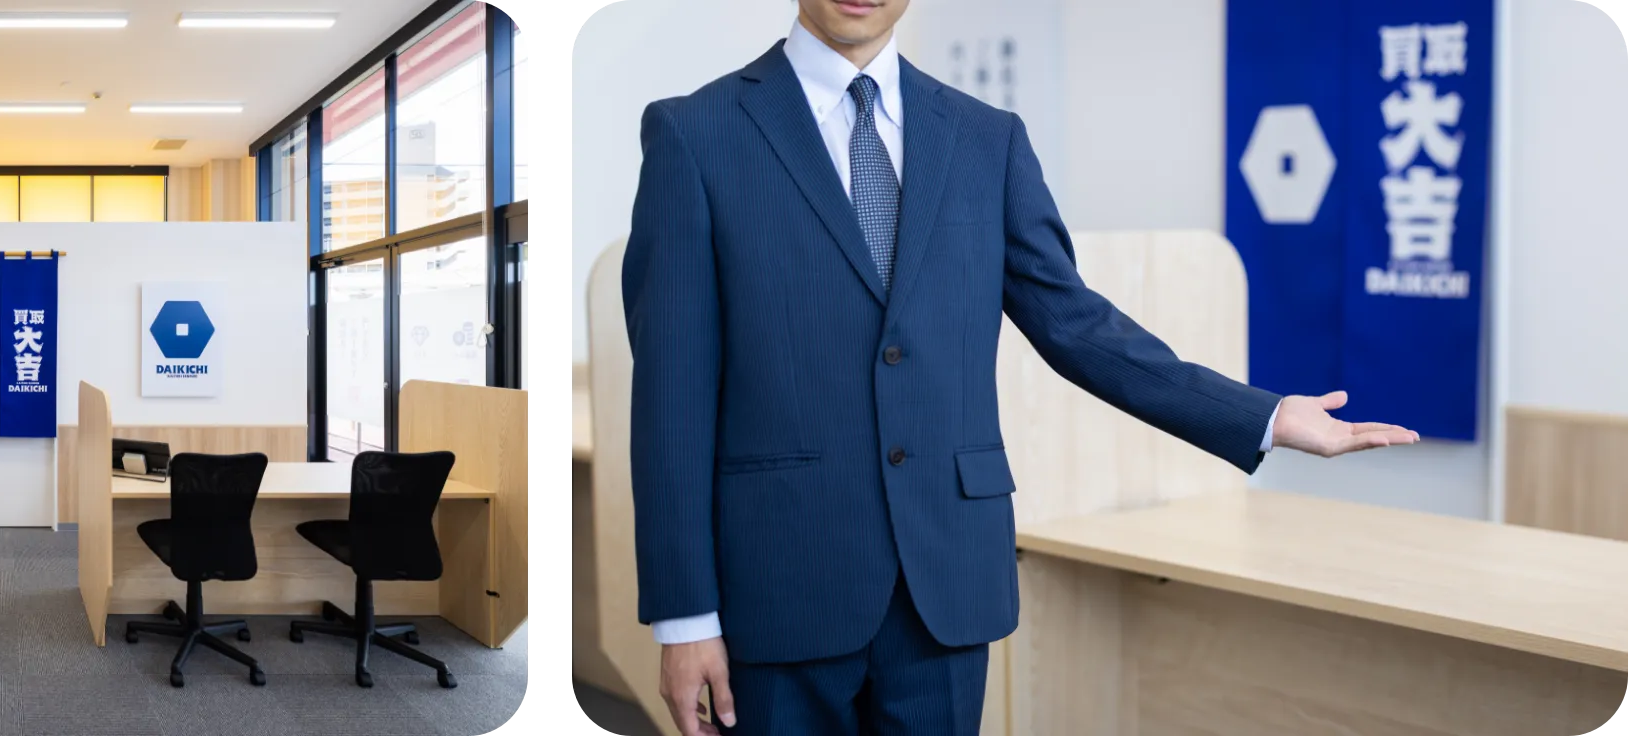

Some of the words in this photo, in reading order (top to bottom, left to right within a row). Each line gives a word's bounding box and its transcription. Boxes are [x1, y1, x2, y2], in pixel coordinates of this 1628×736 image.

[1378, 80, 1464, 262] 大吉
[13, 308, 44, 325] 買取
[13, 325, 44, 381] 大吉
[156, 364, 208, 374] DAIKICHI
[8, 384, 48, 392] DAIKICHI
